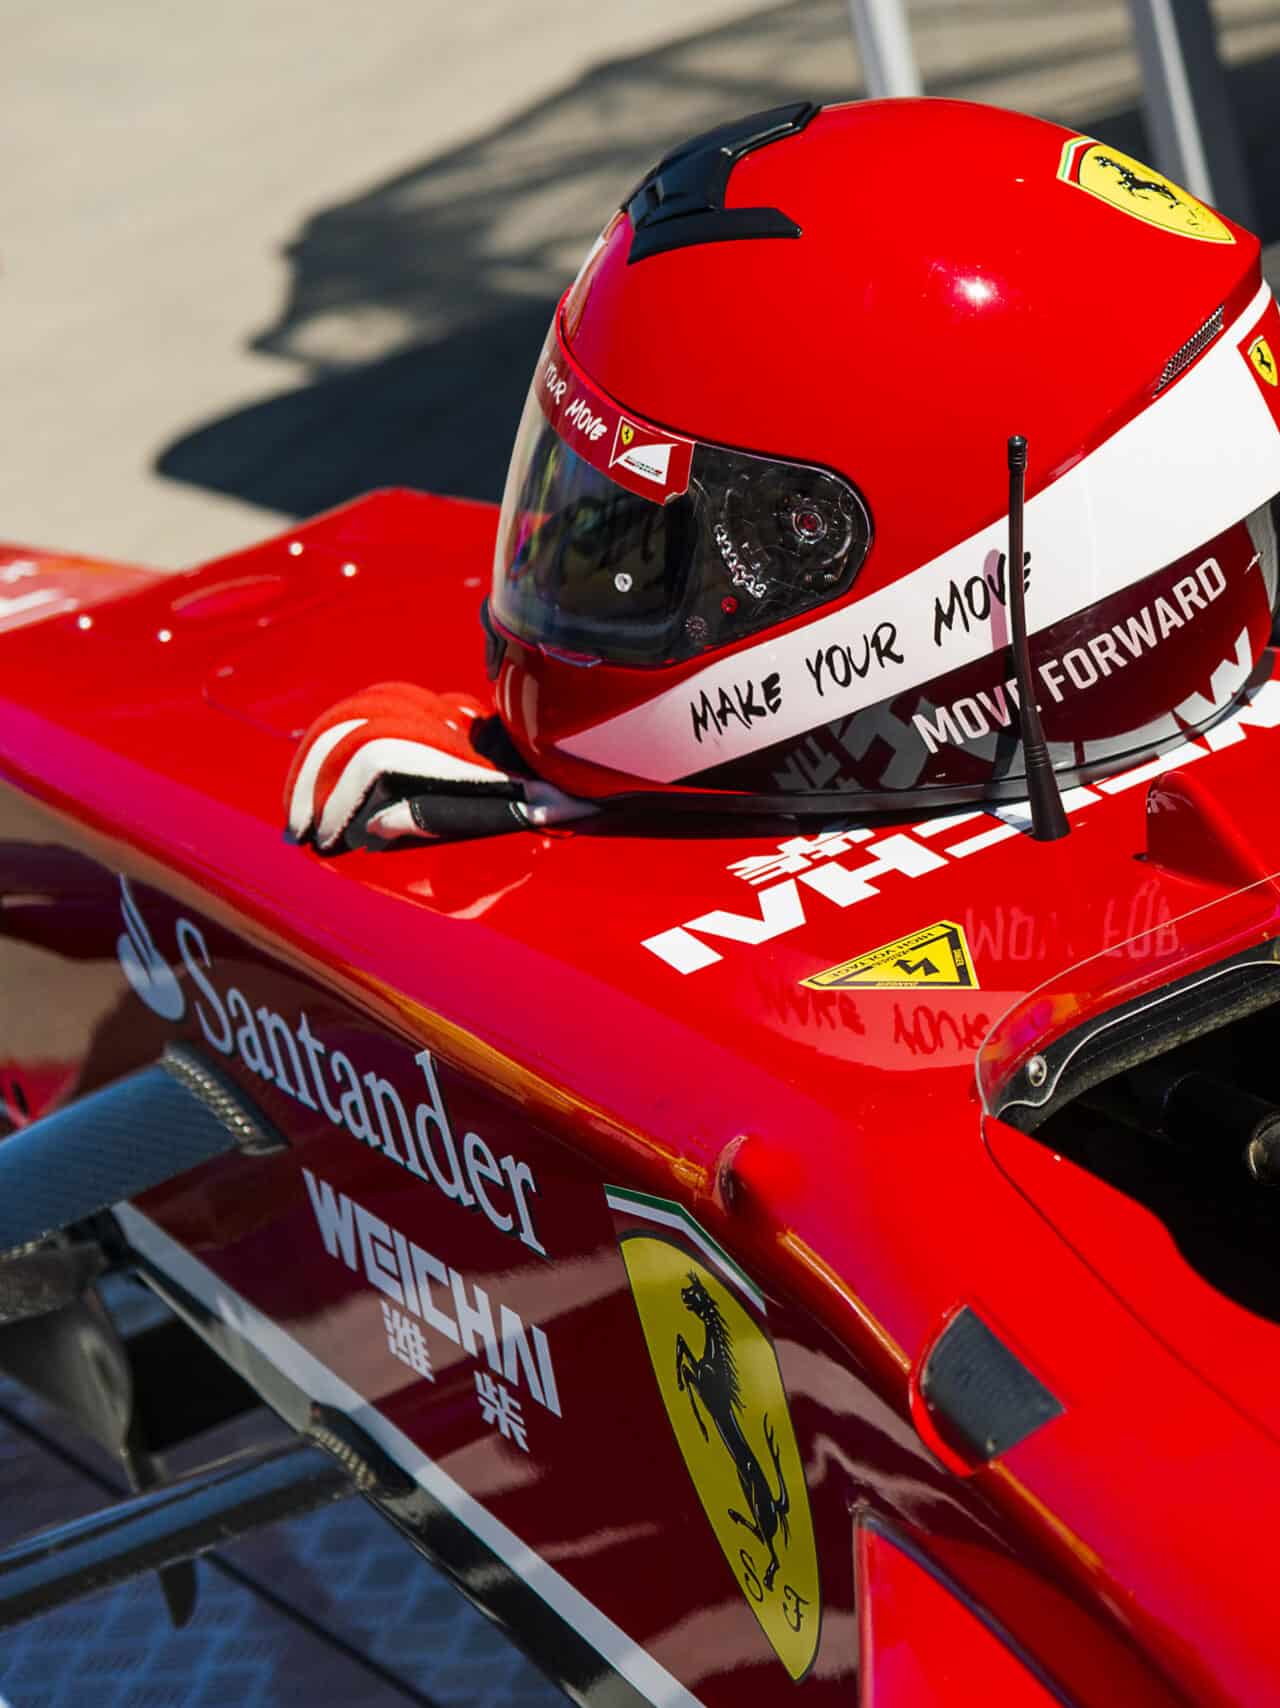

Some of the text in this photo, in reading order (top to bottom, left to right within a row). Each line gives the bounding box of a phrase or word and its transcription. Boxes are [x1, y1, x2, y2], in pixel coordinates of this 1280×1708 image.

[565, 399, 607, 440] MOVE
[690, 672, 782, 743] MAKE
[805, 622, 904, 696] YOUR
[1038, 557, 1227, 703] FORWARD
[831, 947, 893, 977] VOLTAGE
[898, 931, 935, 950] HIGH
[176, 918, 548, 1257] Santander
[301, 1167, 562, 1418] WEICHAI
